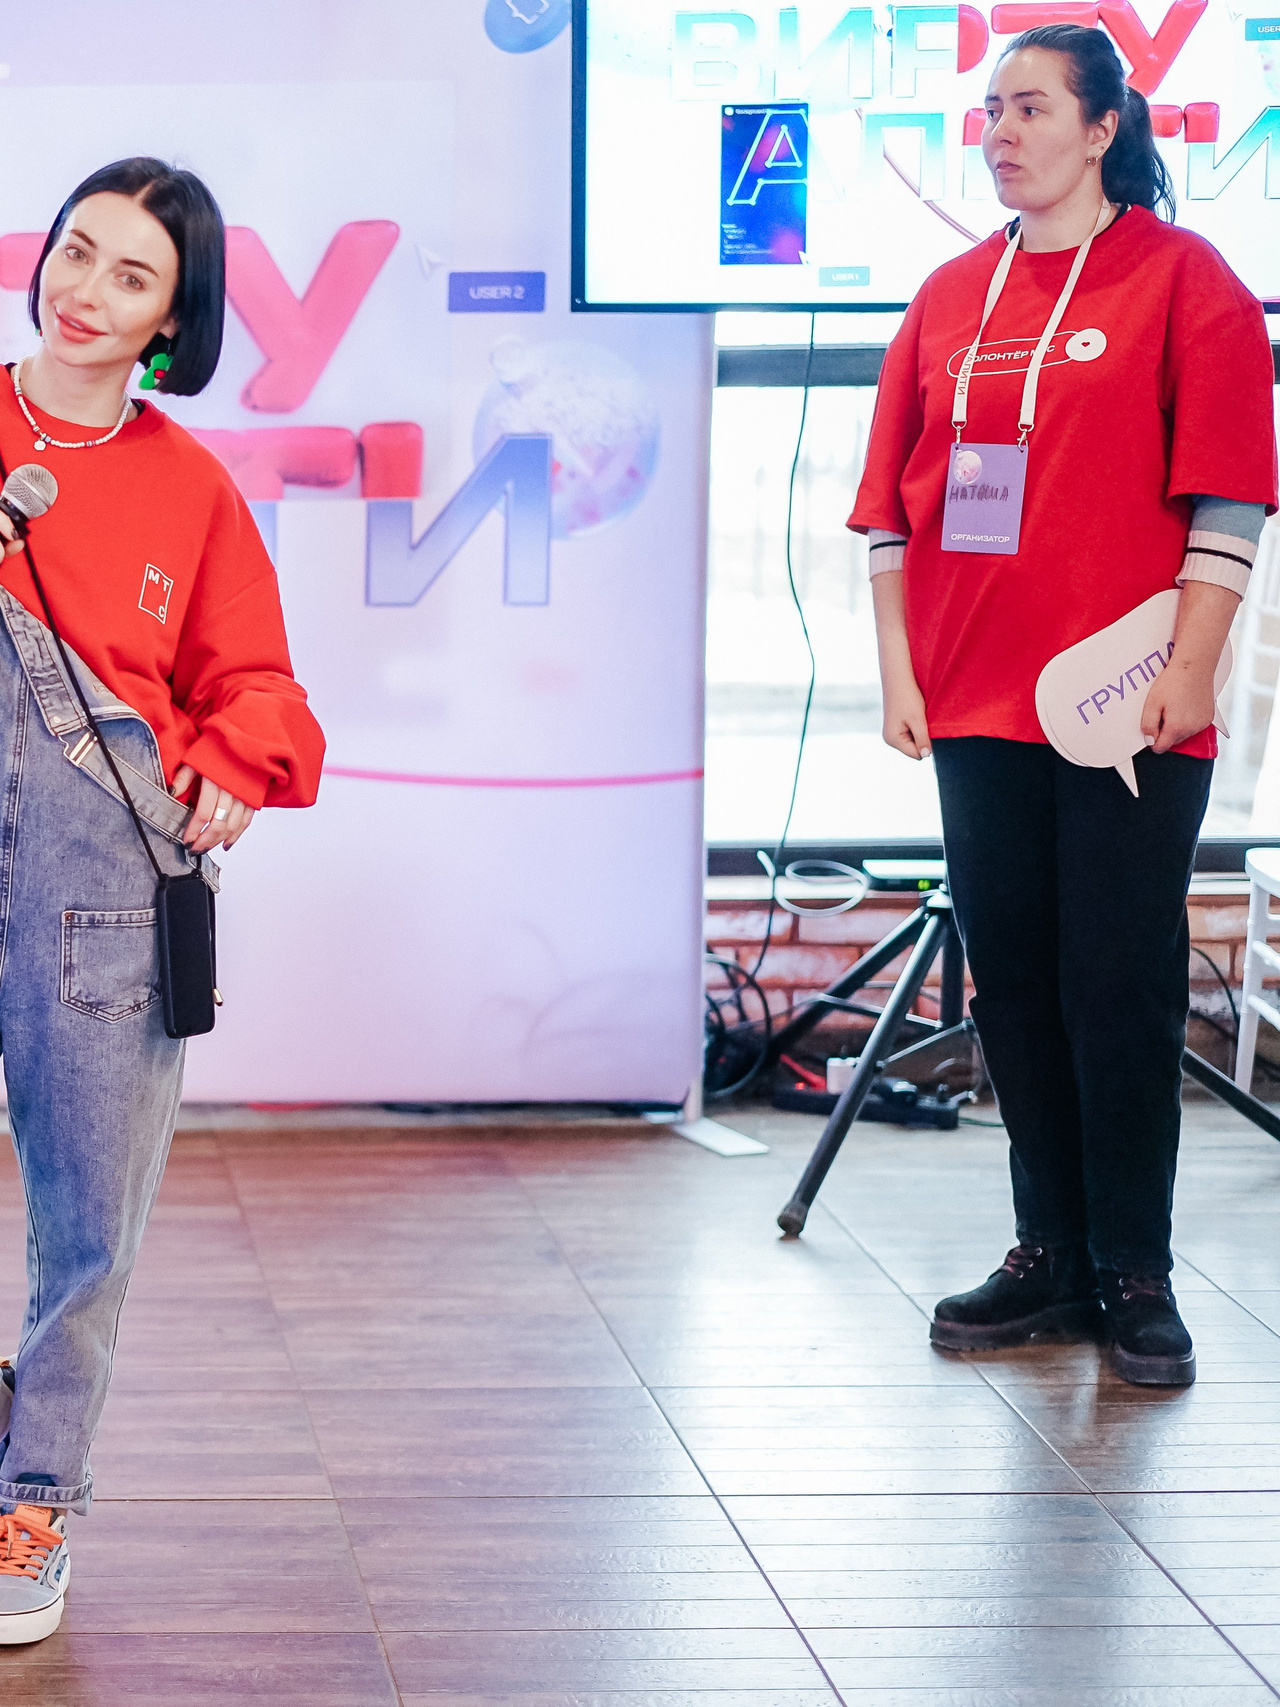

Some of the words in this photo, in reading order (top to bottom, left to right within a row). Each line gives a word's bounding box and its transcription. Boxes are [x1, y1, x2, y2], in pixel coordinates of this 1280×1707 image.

[673, 0, 1208, 100] ВИРУ
[468, 285, 513, 300] USER
[513, 284, 526, 300] 2
[973, 349, 1031, 363] ОЛОНТЁР
[950, 533, 1011, 543] ОРГАНИЗАТОР
